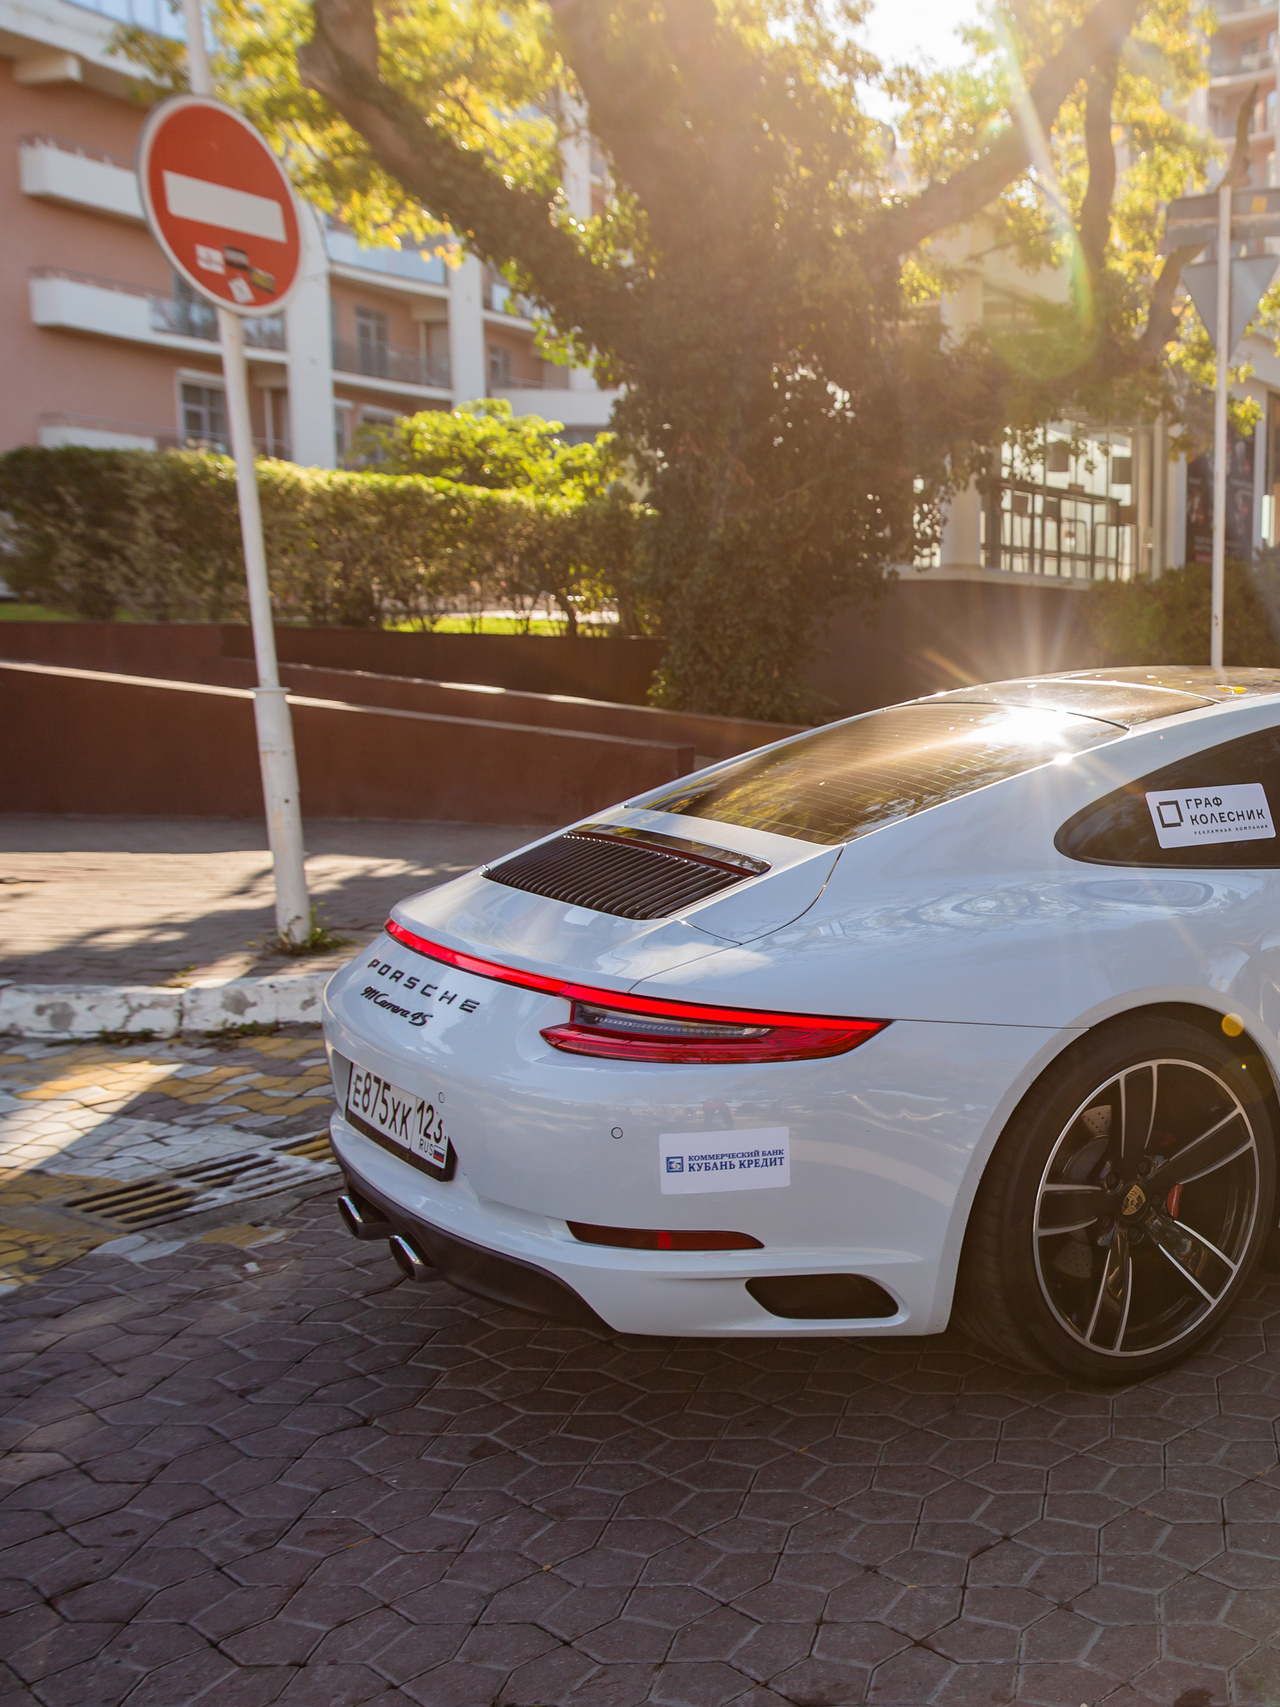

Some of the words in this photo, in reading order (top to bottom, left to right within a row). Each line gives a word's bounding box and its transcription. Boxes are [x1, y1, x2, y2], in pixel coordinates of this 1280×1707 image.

[1185, 796, 1223, 810] ГРАФ
[1190, 808, 1266, 826] КОЛЕСНИК
[1194, 827, 1232, 835] РЕКЛАМНАЯ
[1235, 824, 1268, 832] КОМПАНИЯ
[367, 958, 480, 1014] PORSCHE
[418, 1138, 434, 1156] RUS
[688, 1150, 760, 1162] КОММЕРЧЕСКИЙ
[761, 1149, 785, 1157] БАНК
[688, 1160, 736, 1172] КУБАНЬ
[738, 1157, 785, 1169] КРЕДИТ
